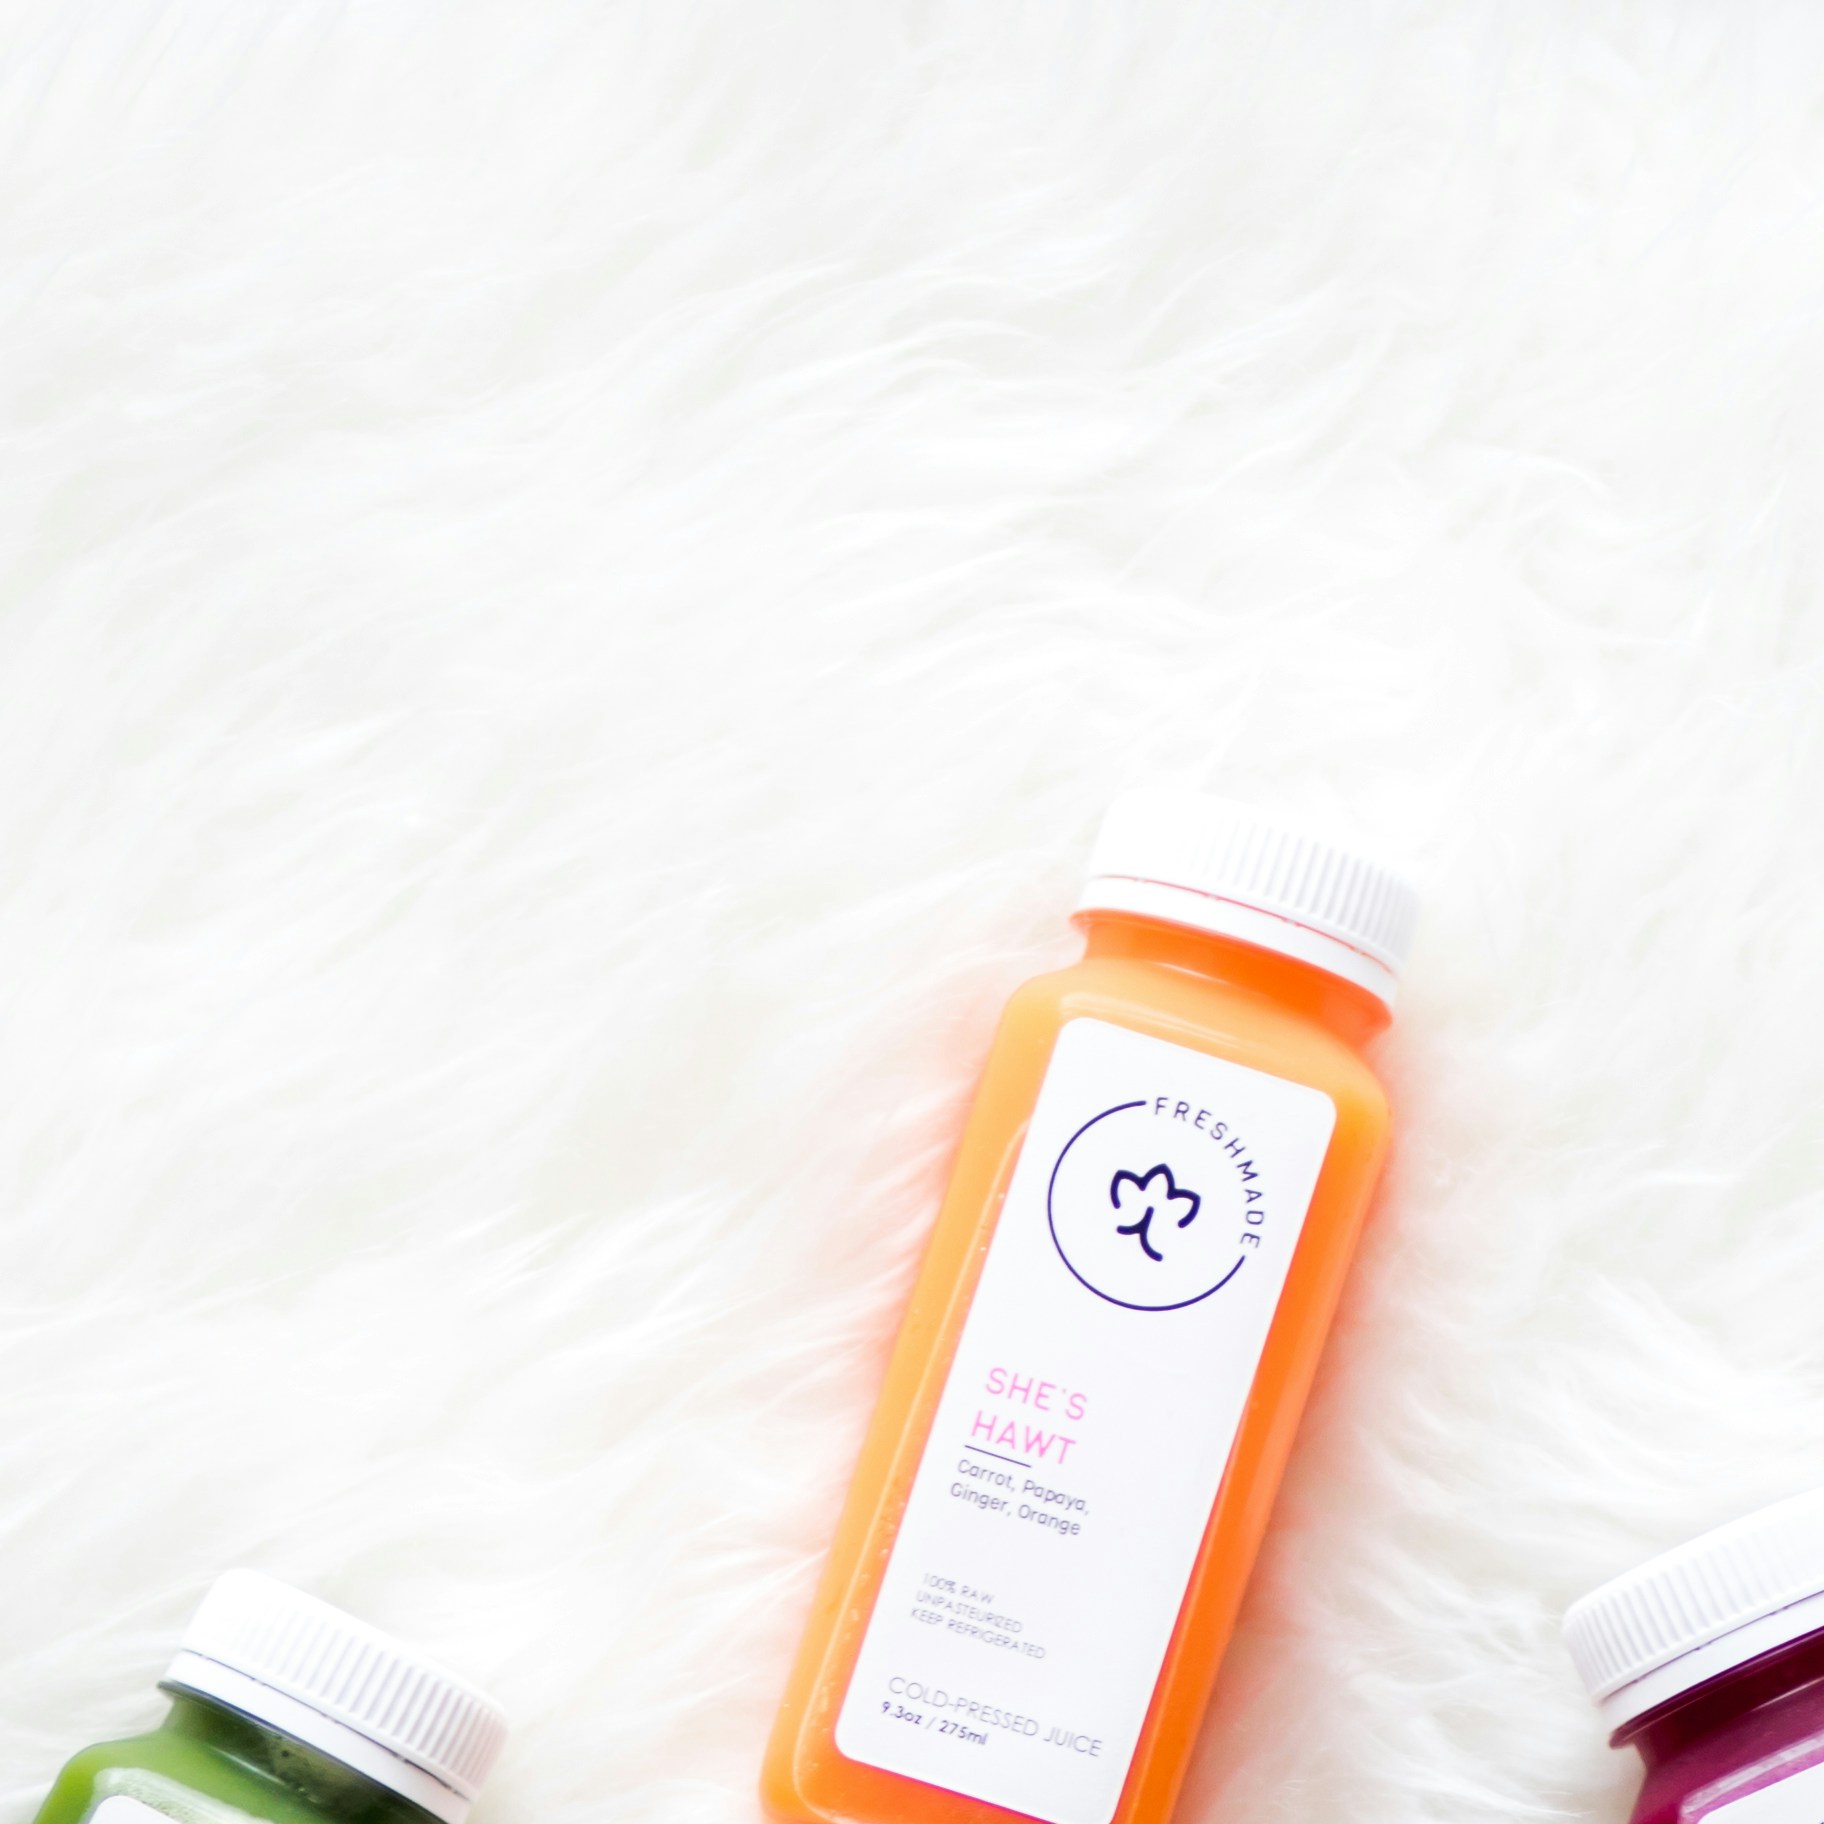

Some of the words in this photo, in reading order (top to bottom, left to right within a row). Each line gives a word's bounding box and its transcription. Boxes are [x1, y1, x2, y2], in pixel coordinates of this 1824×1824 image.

[1154, 1096, 1265, 1249] FRESHMADE
[985, 1367, 1087, 1421] SHE'S
[971, 1410, 1077, 1464] HAWT
[950, 1482, 1011, 1516] Ginger,
[1018, 1504, 1081, 1535] Orange
[958, 1459, 1015, 1492] Carrot,
[1022, 1480, 1088, 1515] Papaya,
[916, 1591, 1022, 1633] UNPASTEURIZED
[924, 1573, 957, 1594] 100%
[960, 1585, 994, 1604] RAW
[911, 1608, 944, 1625] KEEP
[947, 1619, 1045, 1659] REFRIGERATED
[882, 1701, 922, 1725] 9.3oz
[938, 1720, 988, 1745] 275ml
[888, 1677, 1040, 1736] COLD-PRESSED
[1043, 1728, 1103, 1757] JUICE
